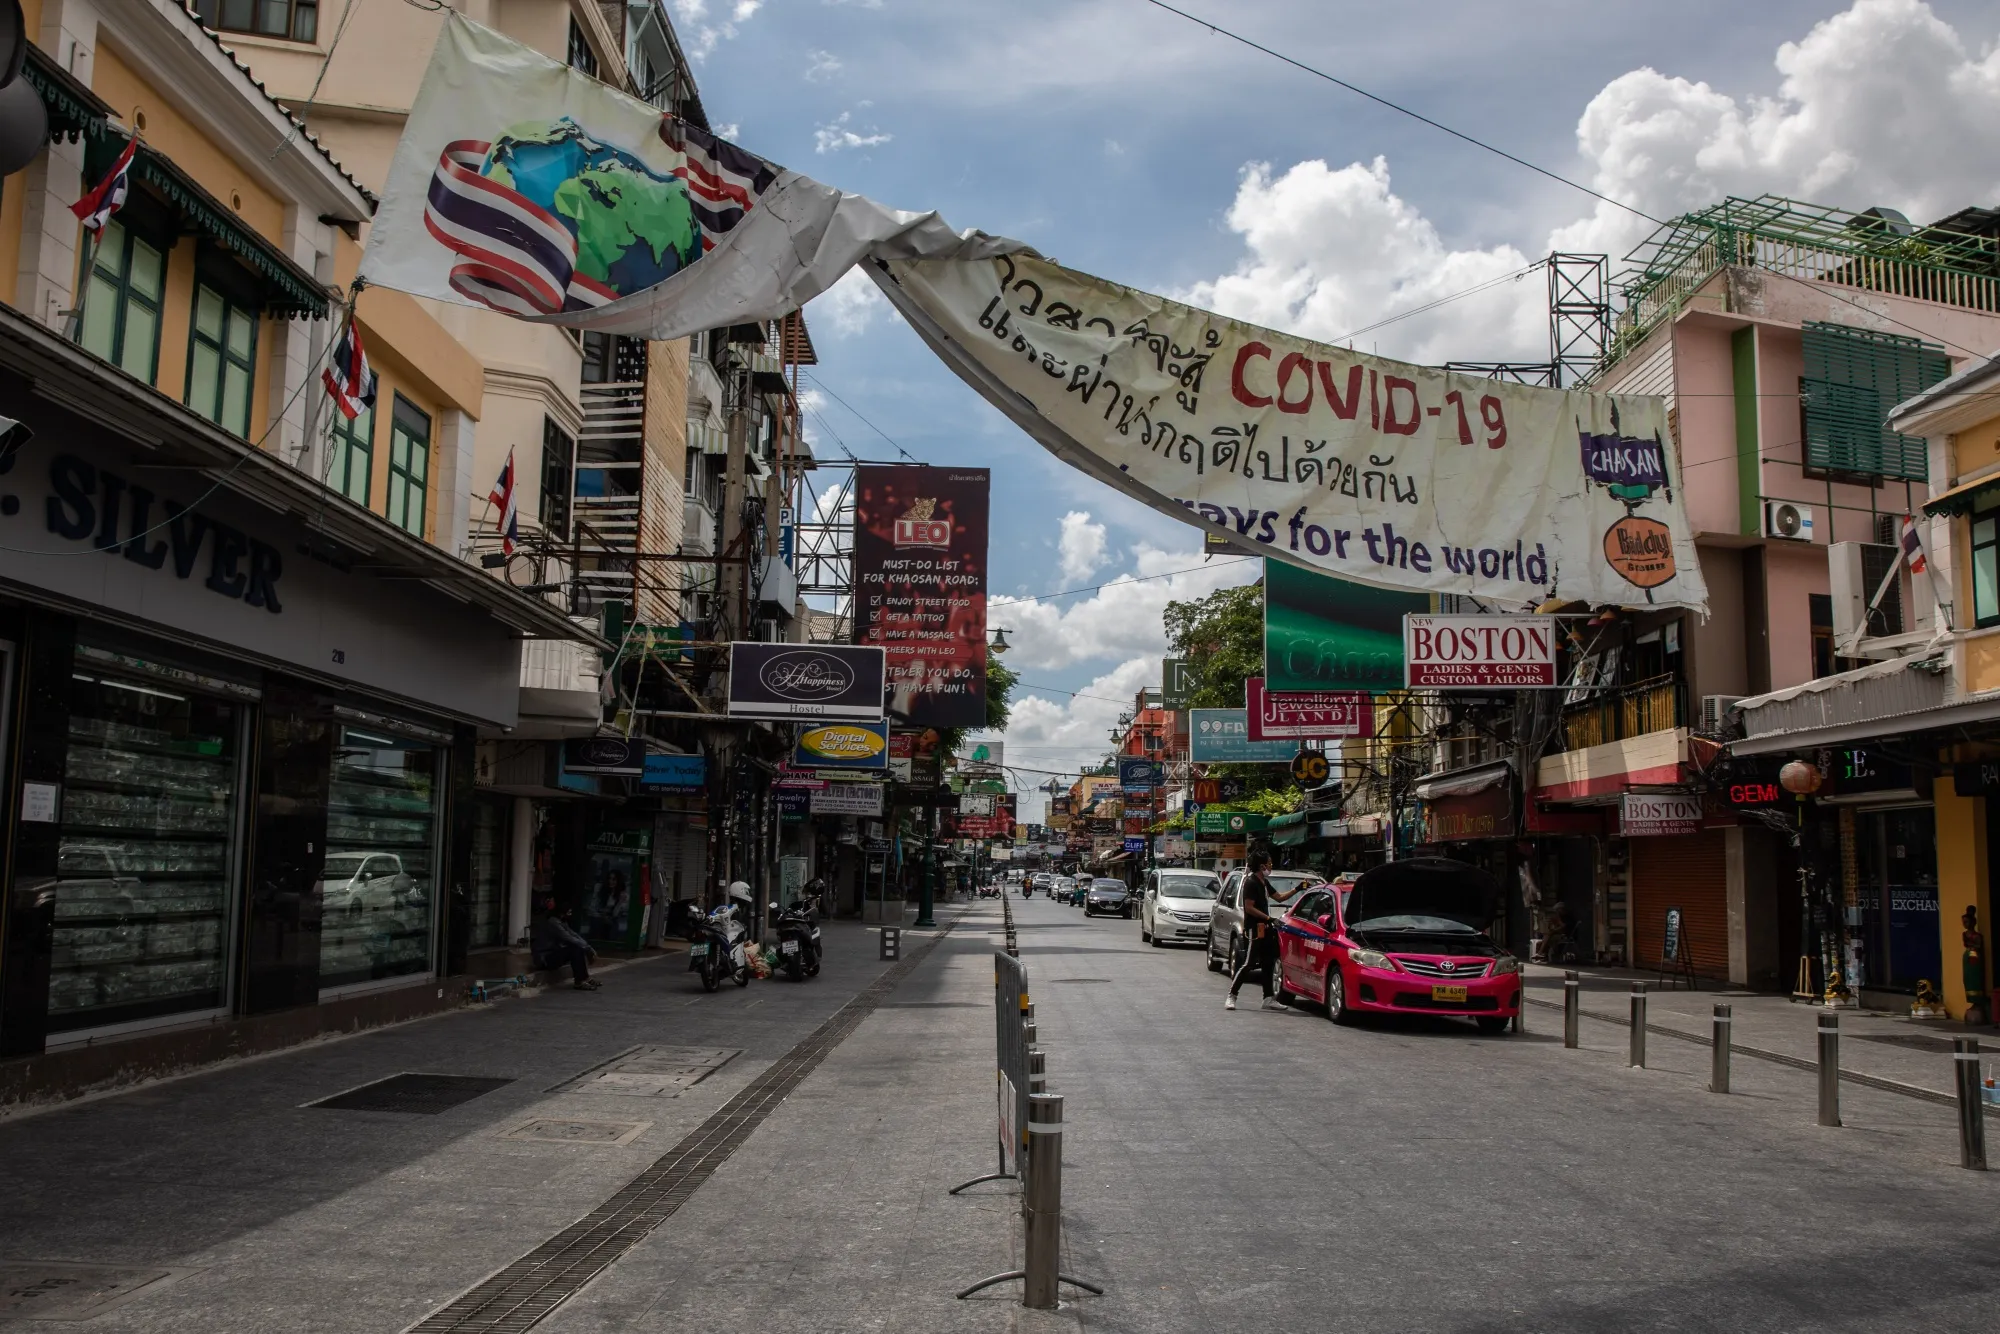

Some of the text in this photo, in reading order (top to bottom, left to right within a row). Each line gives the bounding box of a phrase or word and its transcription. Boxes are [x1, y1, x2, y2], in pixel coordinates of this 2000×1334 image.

[1232, 341, 1507, 449] COVID-19
[1592, 447, 1660, 477] KHAOSAN
[46, 453, 284, 614] SILVER
[897, 521, 948, 544] LEO
[1288, 506, 1351, 560] for
[1361, 522, 1432, 574] the
[1441, 538, 1548, 586] world
[882, 559, 960, 572] MUST-DO LIST
[863, 573, 886, 584] FOR
[888, 573, 942, 585] KHAOSAN
[886, 597, 970, 607] ENJOY STREET FOOD
[886, 613, 945, 622] GET A TATTOO
[1411, 618, 1434, 626] NEW
[885, 630, 955, 640] HAVE A MASSAGE
[1411, 627, 1550, 661] BOSTON
[884, 646, 956, 655] CHEERS WITH LEO
[927, 667, 950, 678] YOU
[1422, 664, 1540, 674] LADIES & GENTS
[800, 676, 844, 688] Happiness
[1420, 675, 1544, 684] CUSTOM TAILORS
[902, 683, 933, 693] HAVE
[936, 683, 966, 694] FUN!
[789, 704, 825, 714] Hostel
[1279, 711, 1342, 722] LAND
[824, 731, 867, 743] Digital
[819, 741, 871, 752] Services
[1295, 757, 1327, 780] JC
[1628, 802, 1698, 819] BOSTON
[594, 831, 625, 845] ATM
[1891, 890, 1930, 899] RAINBOW
